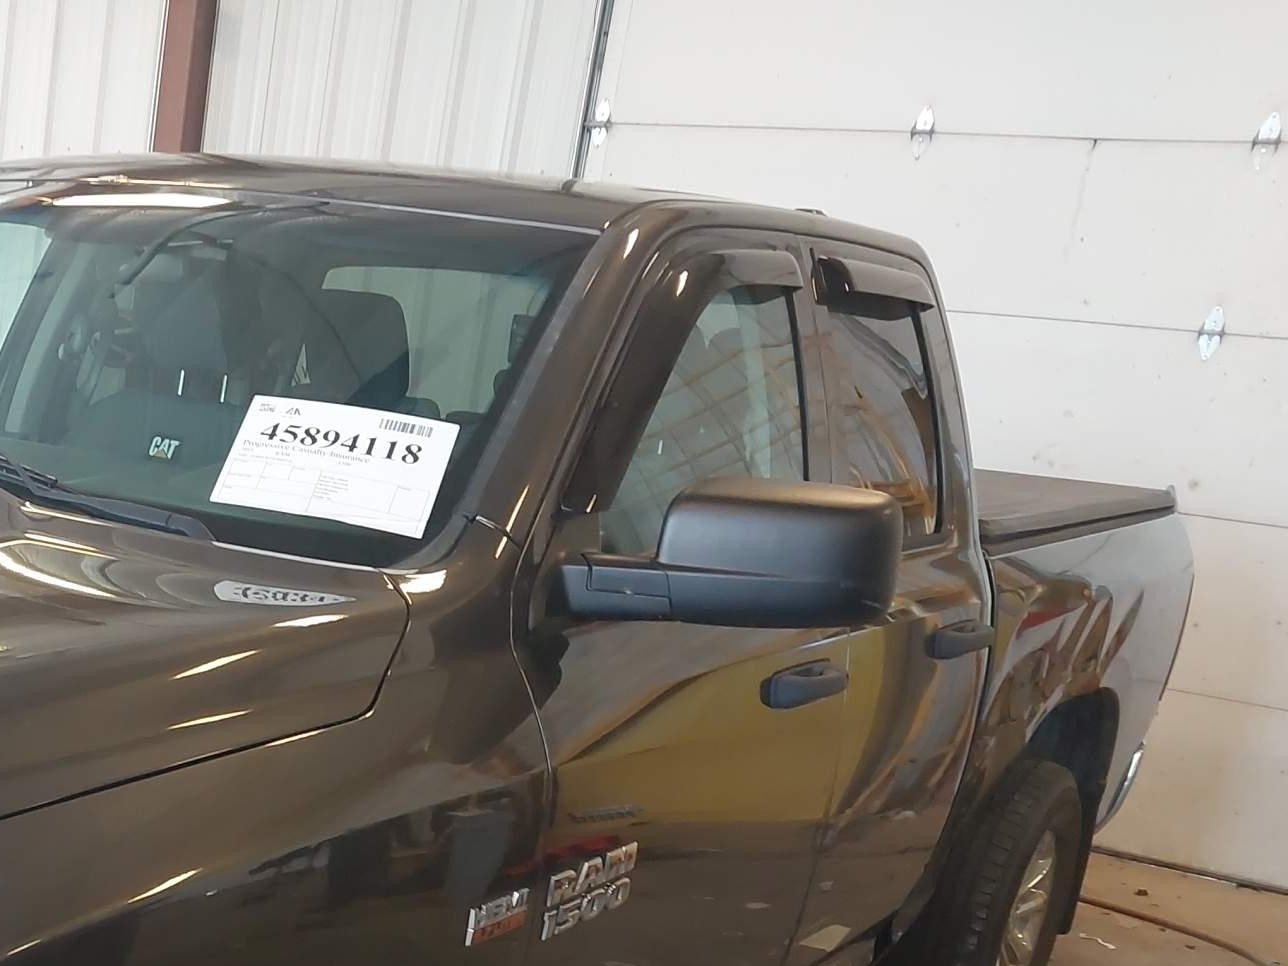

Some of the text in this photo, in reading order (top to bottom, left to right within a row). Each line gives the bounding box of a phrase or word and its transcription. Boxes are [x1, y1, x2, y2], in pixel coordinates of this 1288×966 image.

[148, 435, 180, 460] CAT
[260, 422, 423, 465] 45894118
[546, 840, 639, 908] RAM
[540, 876, 632, 942] 1500
